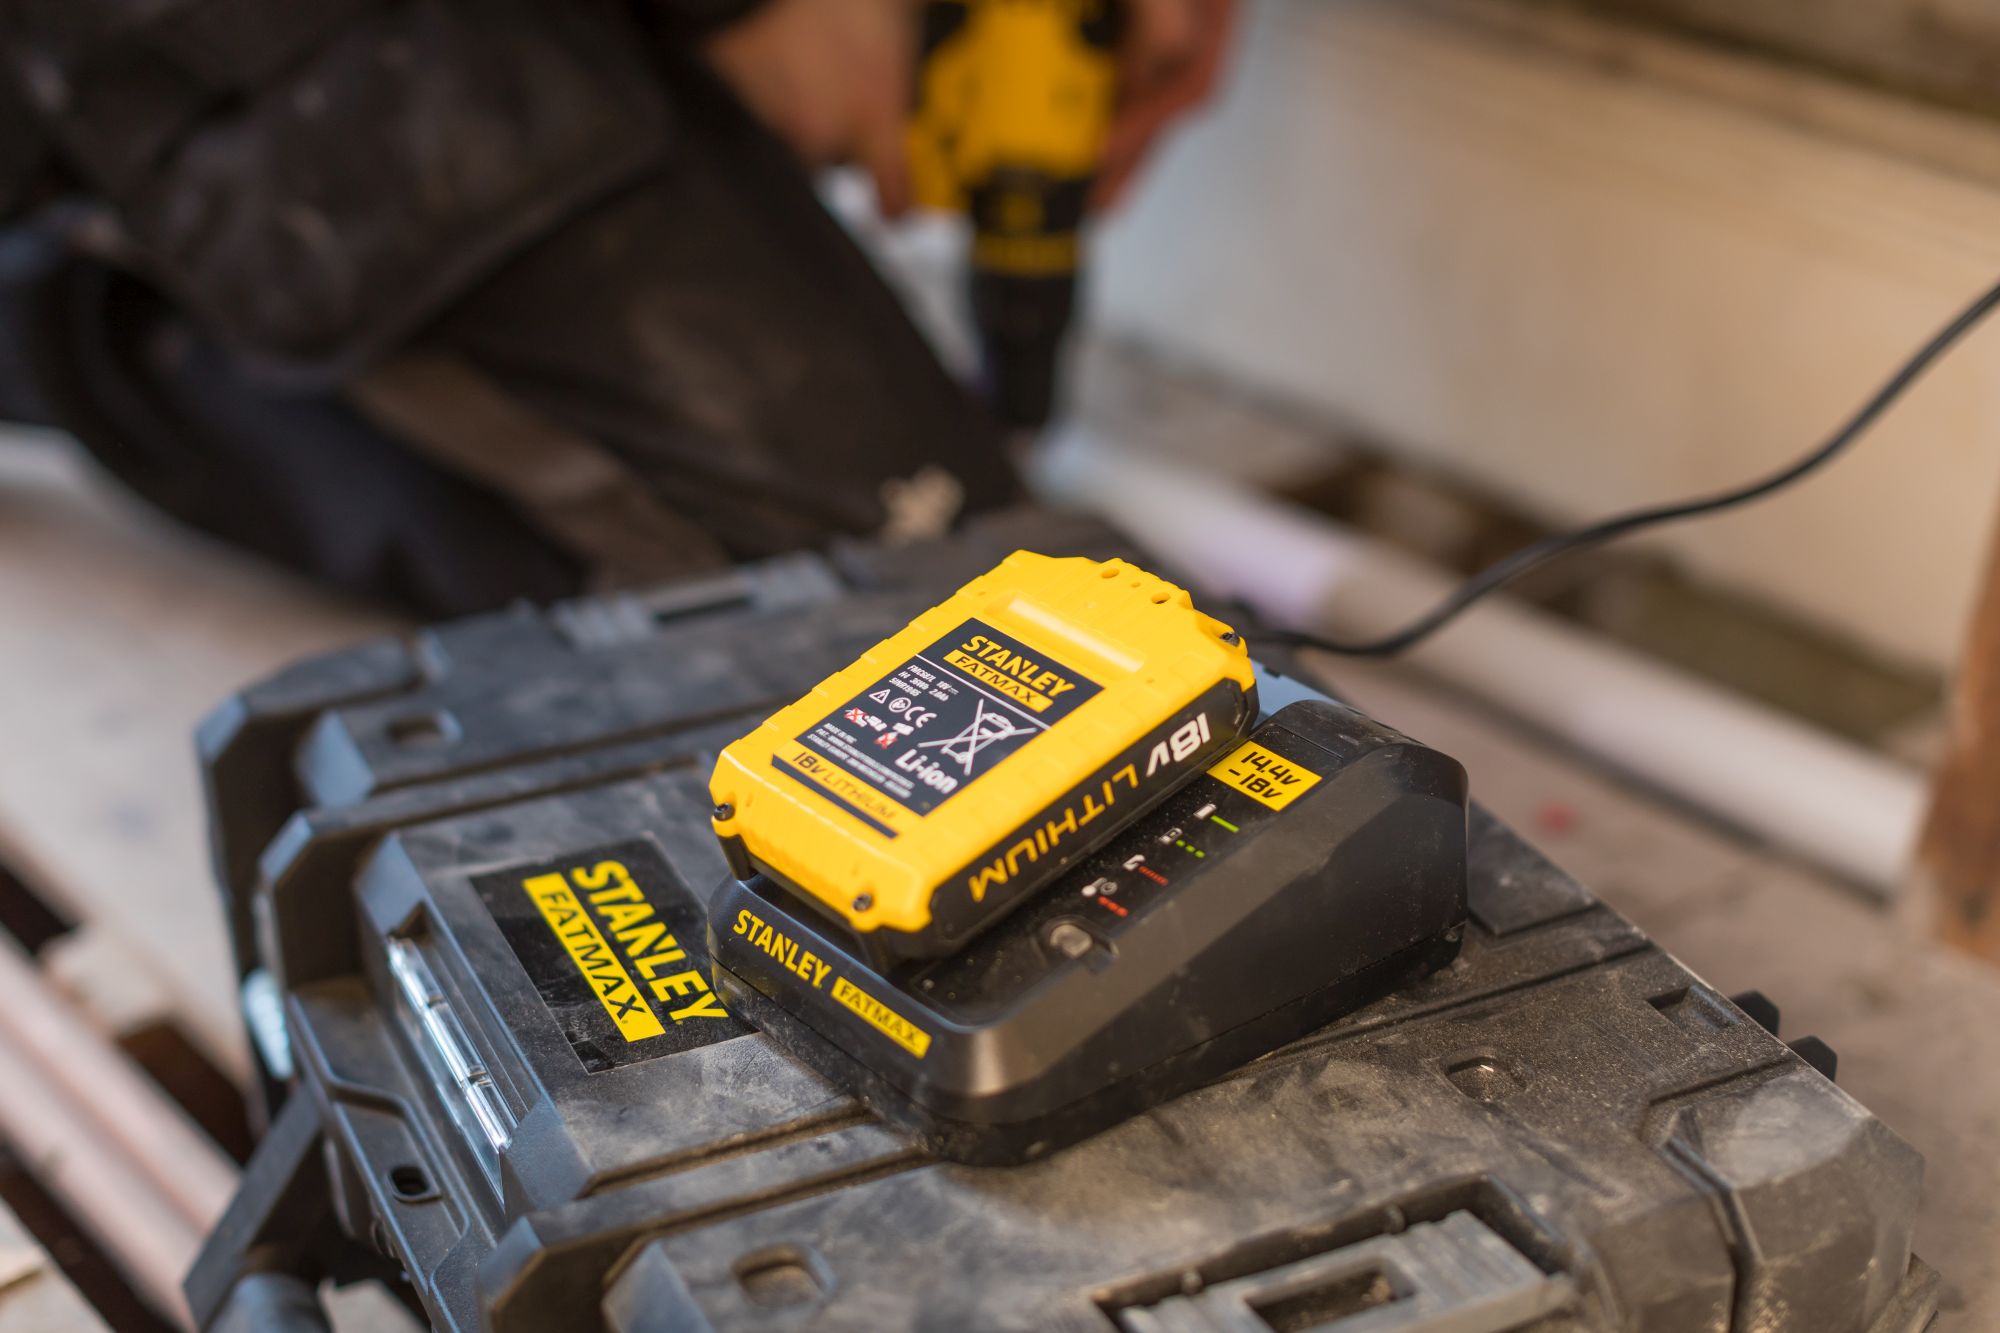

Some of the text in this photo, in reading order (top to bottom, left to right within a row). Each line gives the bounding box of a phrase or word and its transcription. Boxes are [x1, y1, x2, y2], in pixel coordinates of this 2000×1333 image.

[955, 656, 1037, 702] FATMAX
[962, 635, 1076, 697] STANLEY
[823, 772, 897, 819] LITHIUM
[969, 763, 1139, 902] LITHIUM
[540, 890, 646, 1019] FATMAX
[572, 860, 728, 1023] STANLEY
[733, 910, 920, 1049] STANLEY FATMAX
